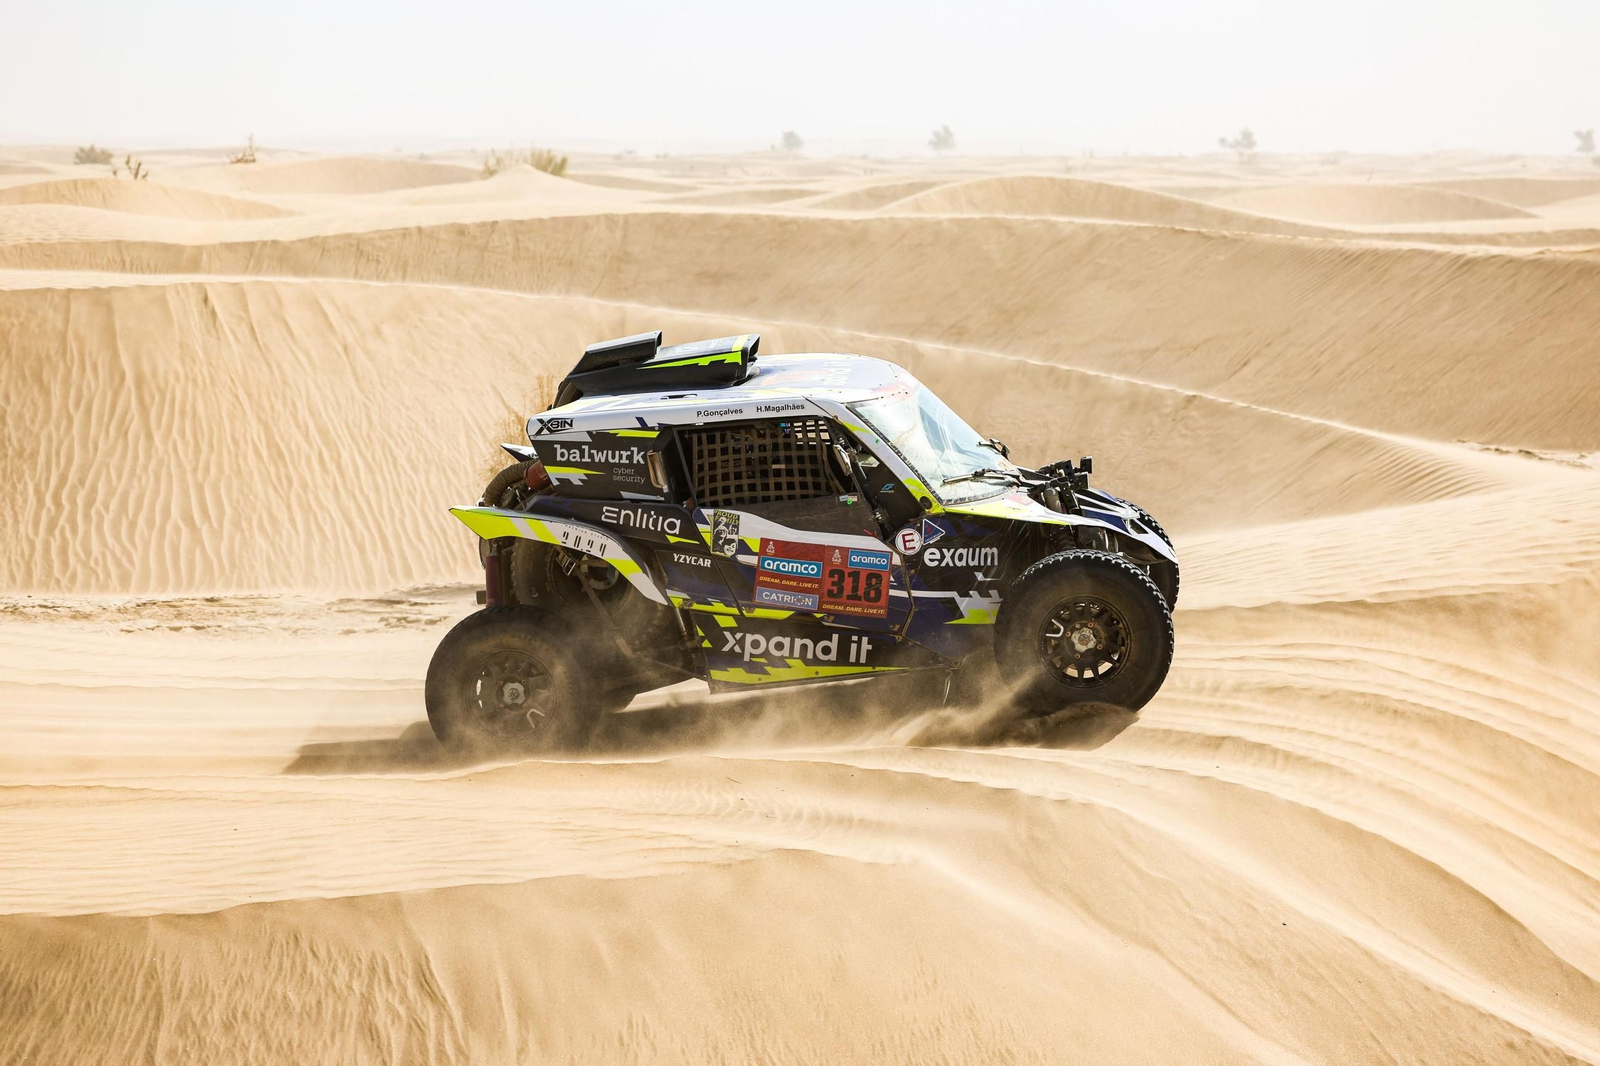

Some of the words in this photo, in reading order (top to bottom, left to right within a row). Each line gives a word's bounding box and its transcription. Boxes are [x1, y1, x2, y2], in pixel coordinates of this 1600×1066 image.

[696, 408, 743, 418] P.Gonçalves
[756, 403, 805, 413] H.Magalhães
[554, 444, 645, 464] balwurk
[612, 467, 635, 475] cyber
[612, 475, 646, 484] security
[902, 533, 916, 551] E
[673, 553, 712, 568] YZYCAR
[850, 555, 888, 566] aramco
[924, 547, 998, 566] exaum
[764, 559, 818, 574] aramco
[759, 576, 781, 584] DREAM.
[827, 569, 883, 602] 318
[721, 630, 839, 662] xpand
[849, 635, 873, 664] it
